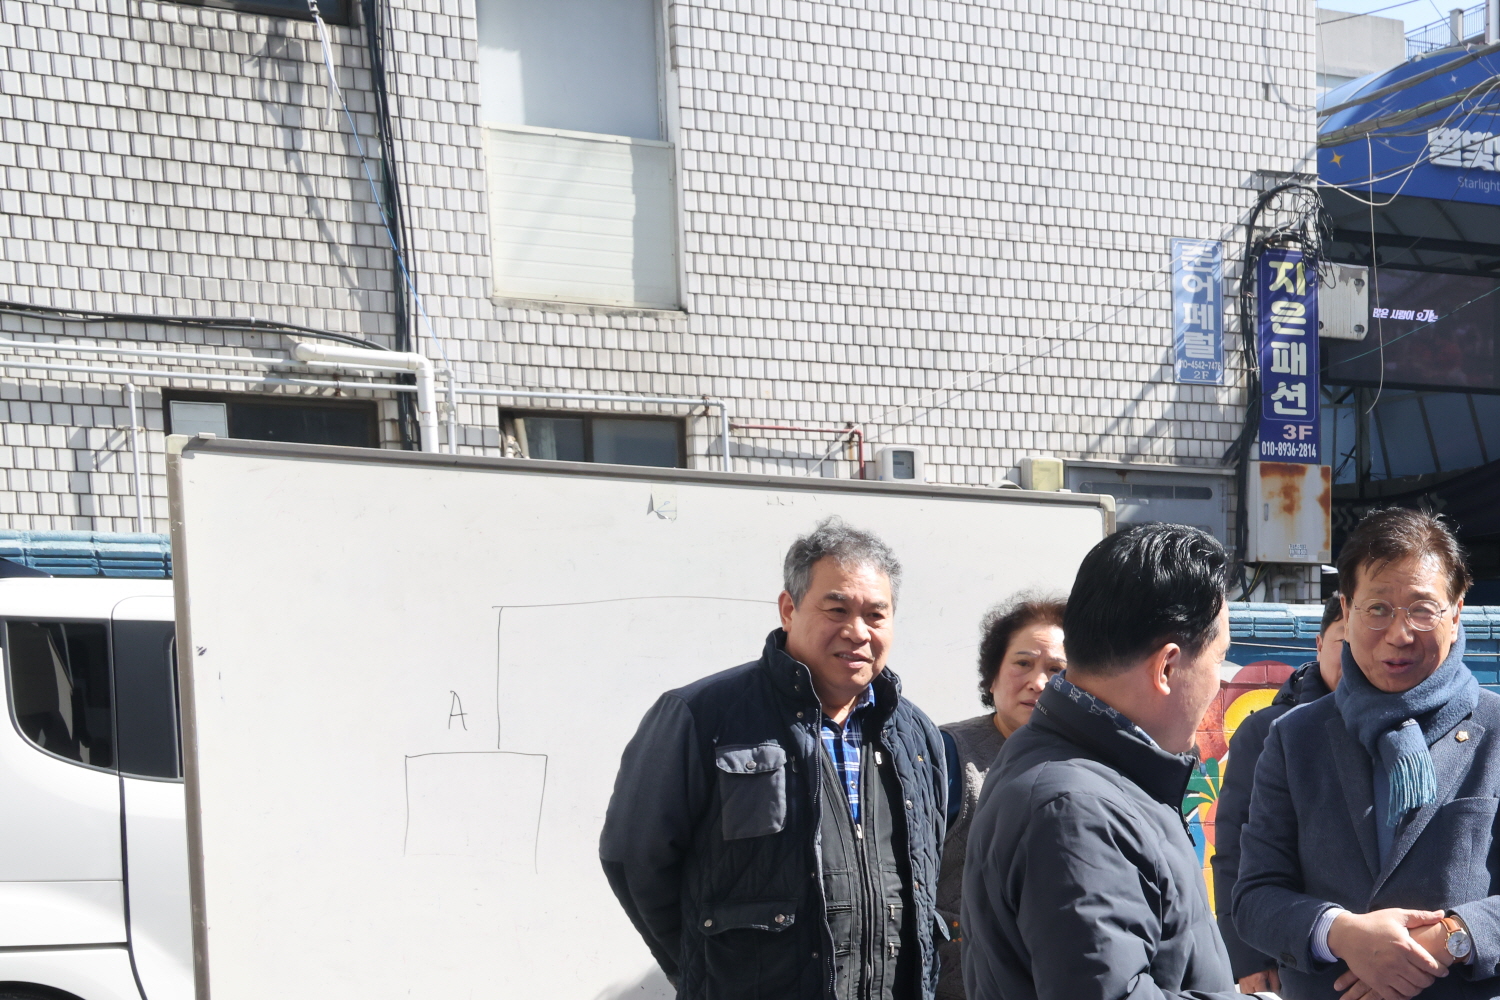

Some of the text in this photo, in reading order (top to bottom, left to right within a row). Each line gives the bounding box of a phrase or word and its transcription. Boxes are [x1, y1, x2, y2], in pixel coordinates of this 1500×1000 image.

[1457, 176, 1500, 192] Starlight
[1268, 261, 1308, 416] 지은패션
[1193, 371, 1209, 380] 2F
[1283, 424, 1313, 440] 3F
[1261, 440, 1317, 458] 010-8936-2814
[448, 690, 468, 731] A
